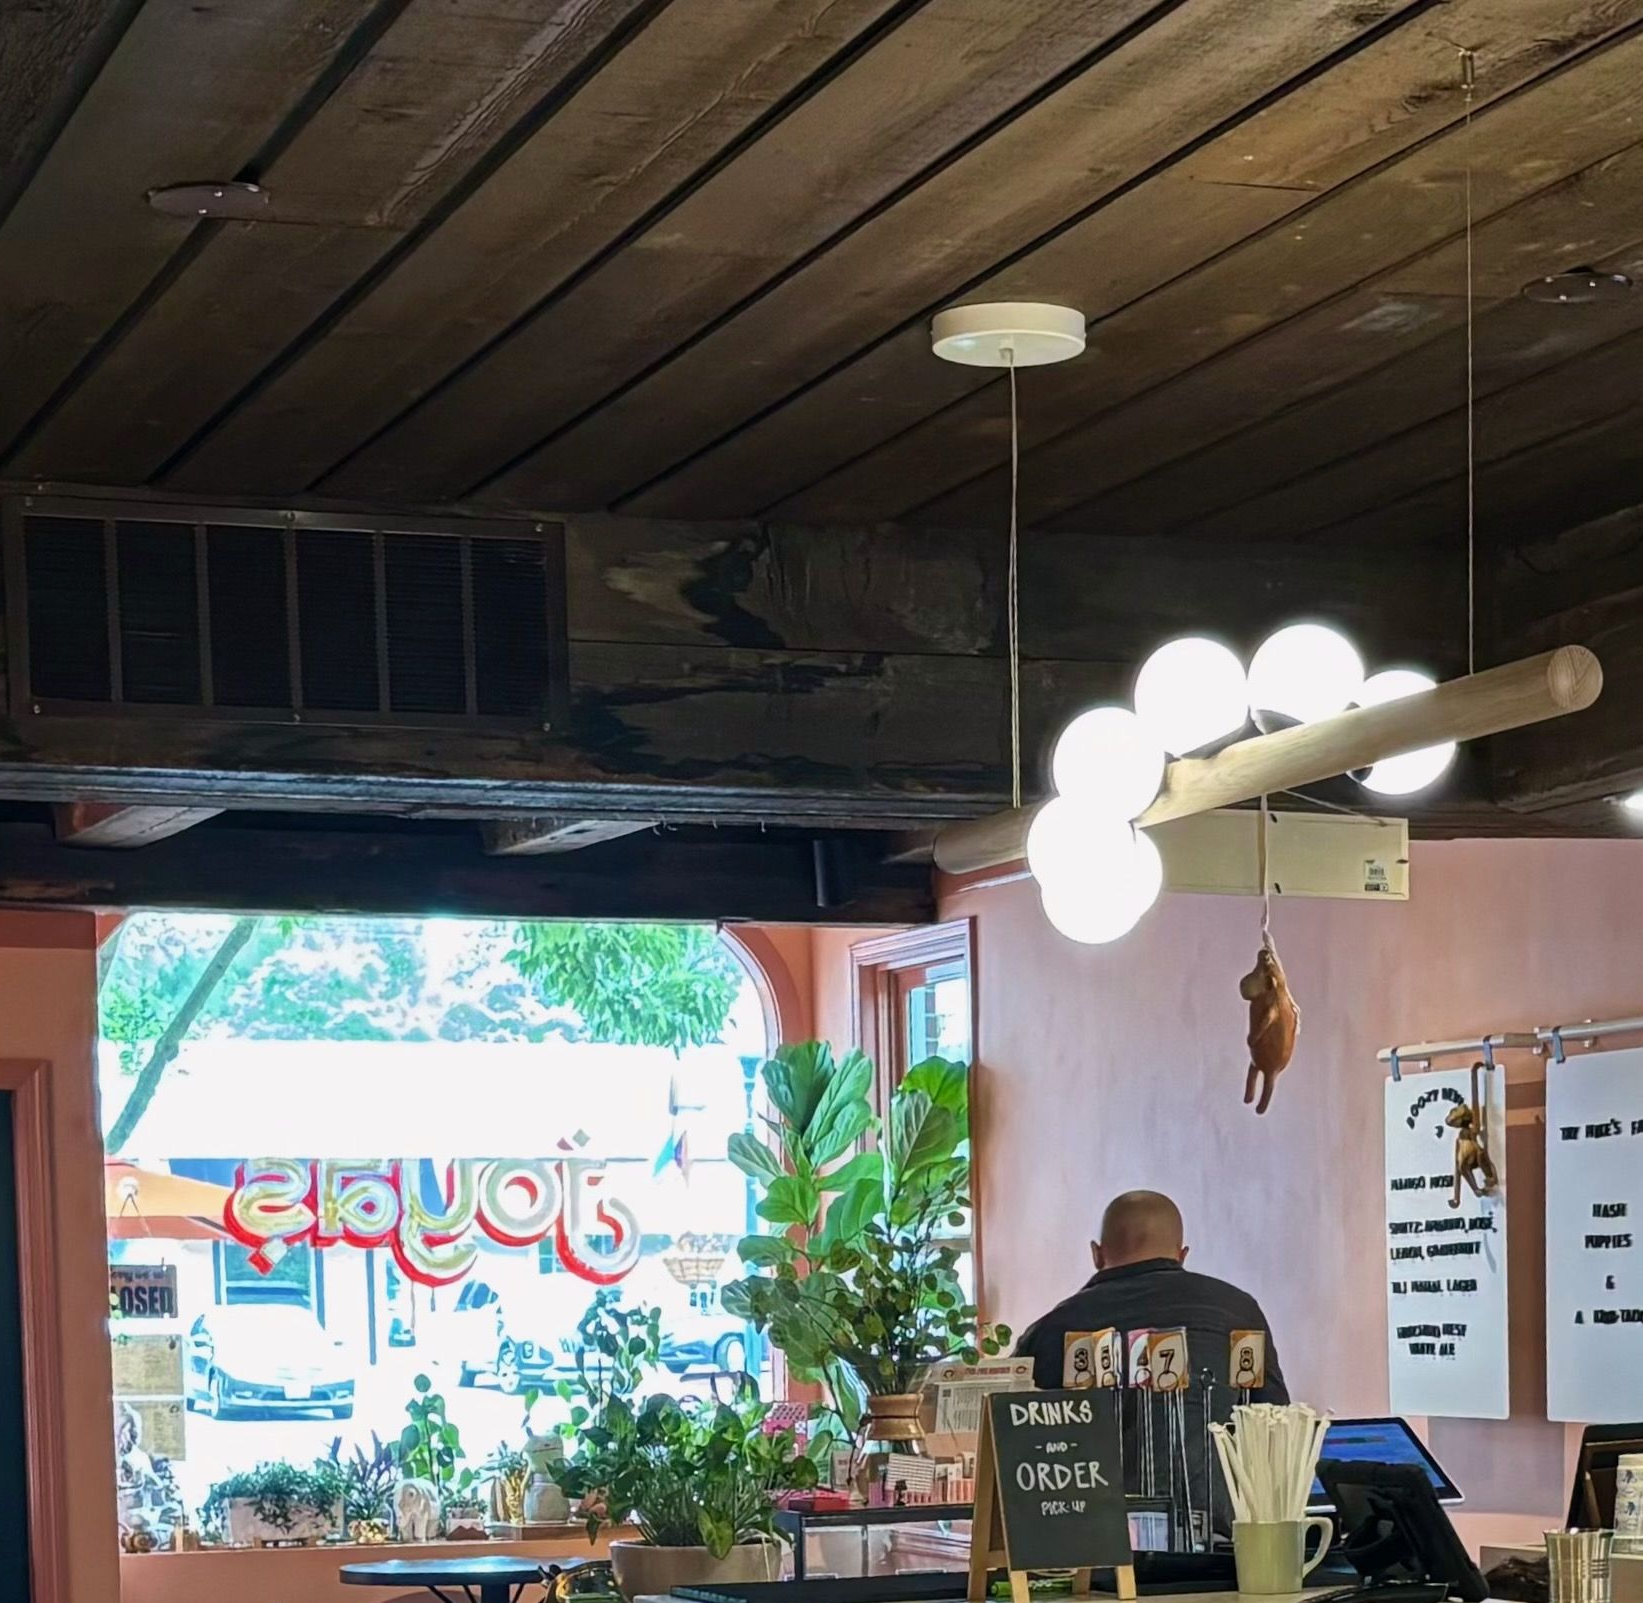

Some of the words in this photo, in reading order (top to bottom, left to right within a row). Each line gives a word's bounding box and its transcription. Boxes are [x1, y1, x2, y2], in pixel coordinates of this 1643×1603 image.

[1074, 1347, 1088, 1372] 3
[1159, 1348, 1175, 1373] 7
[1239, 1346, 1255, 1371] 8
[1009, 1400, 1093, 1426] DRINKS
[1016, 1461, 1109, 1491] ORDER
